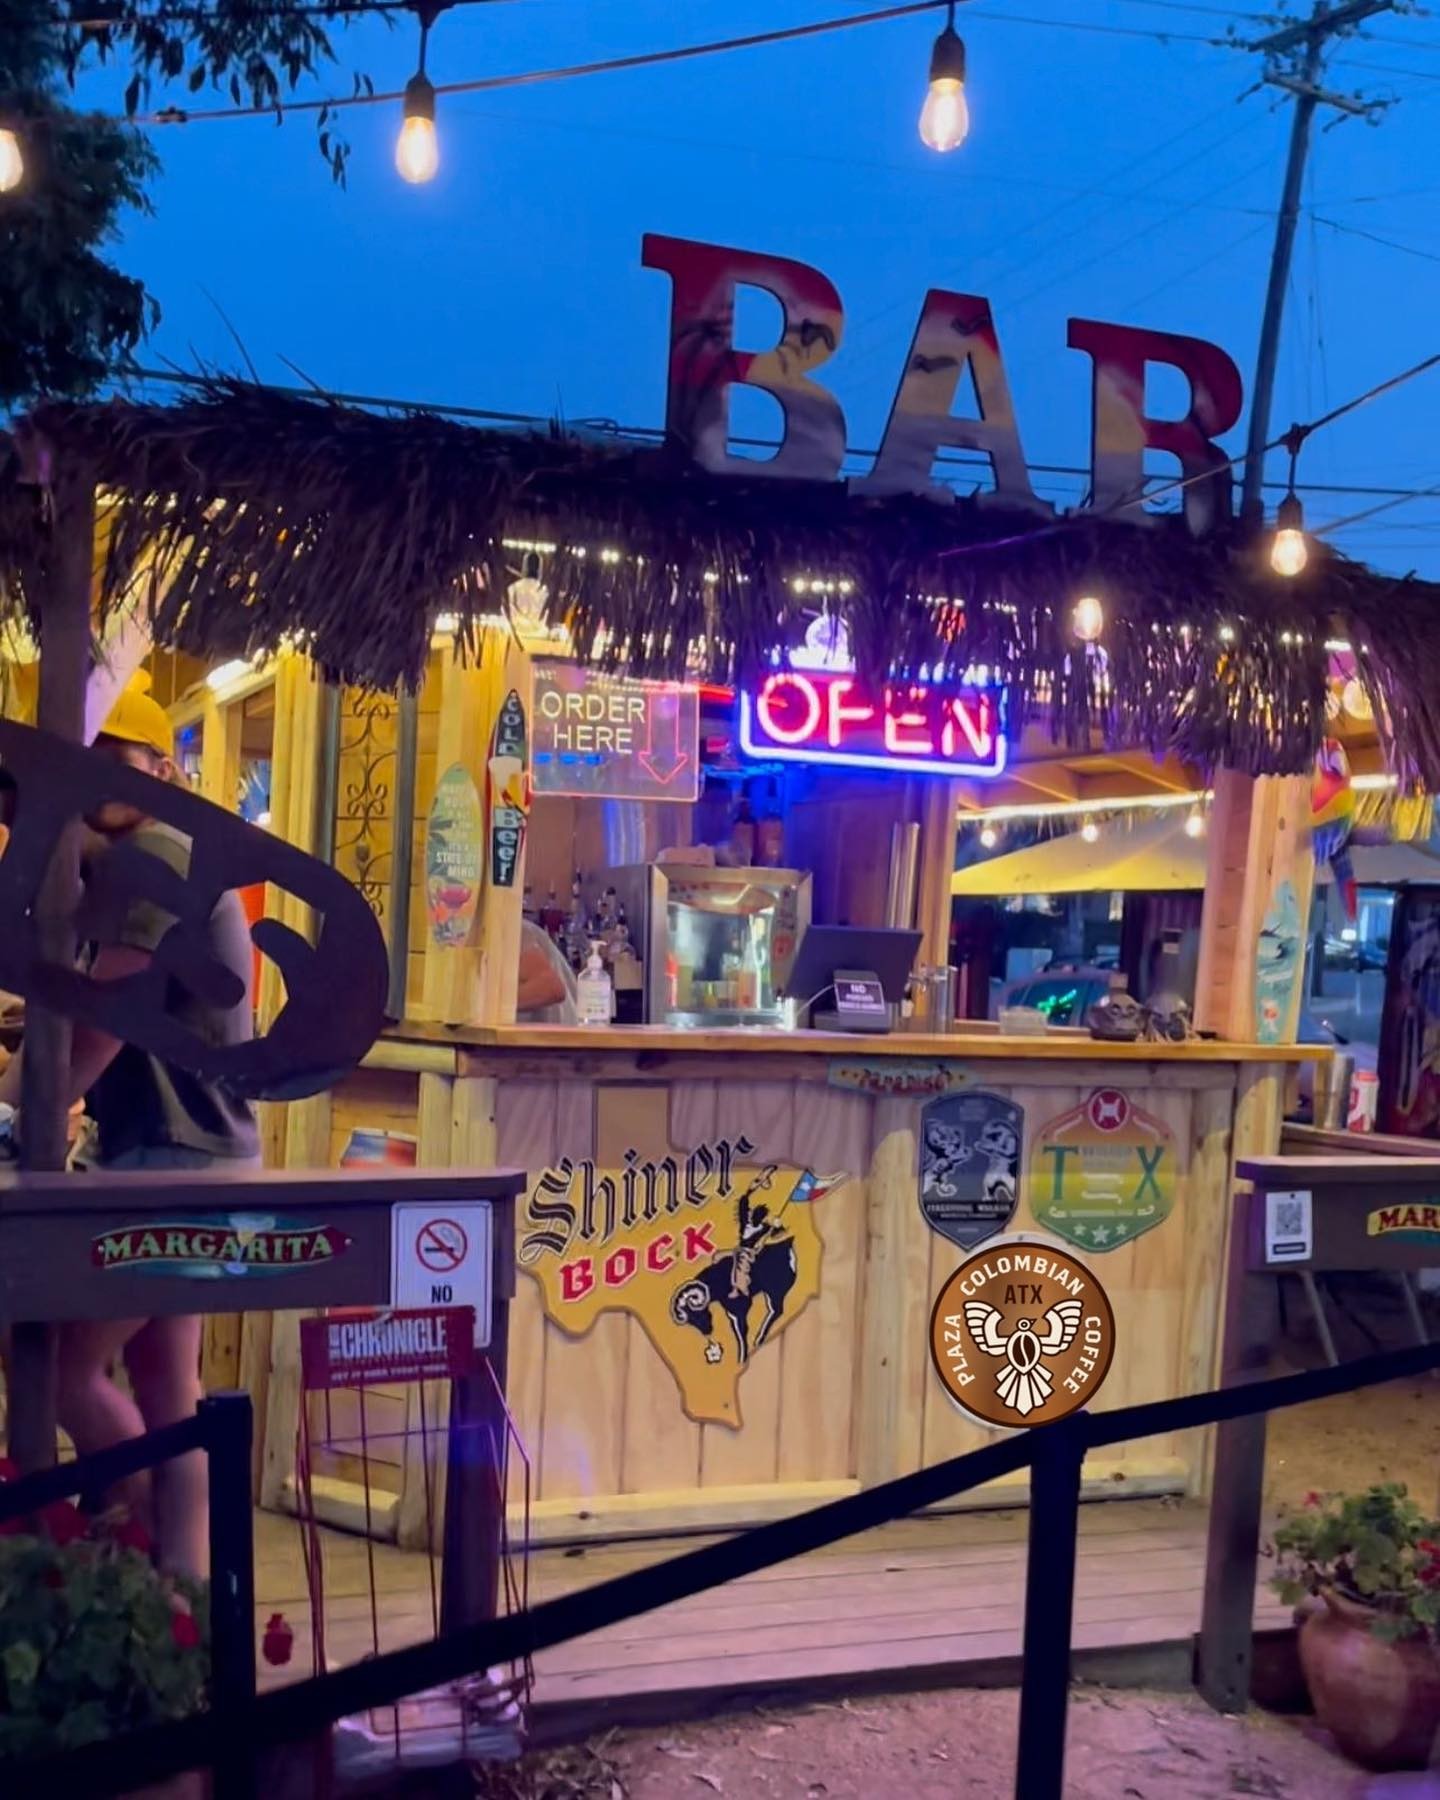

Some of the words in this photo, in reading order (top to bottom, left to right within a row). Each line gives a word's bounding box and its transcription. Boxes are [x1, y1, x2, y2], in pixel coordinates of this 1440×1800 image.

[641, 232, 1244, 538] BAR
[540, 690, 646, 724] ORDER
[757, 672, 991, 758] OPEN
[553, 722, 633, 754] HERE
[518, 1134, 755, 1266] Shiner
[102, 1231, 333, 1265] MARGARITA
[559, 1222, 718, 1303] BOCK
[431, 1285, 453, 1304] NO
[960, 1254, 1085, 1296] COLOMBIAN
[1004, 1284, 1044, 1305] ATX
[340, 1315, 449, 1361] CHRONICLE
[943, 1313, 976, 1387] PLAZA
[1062, 1315, 1102, 1395] COFFEE
